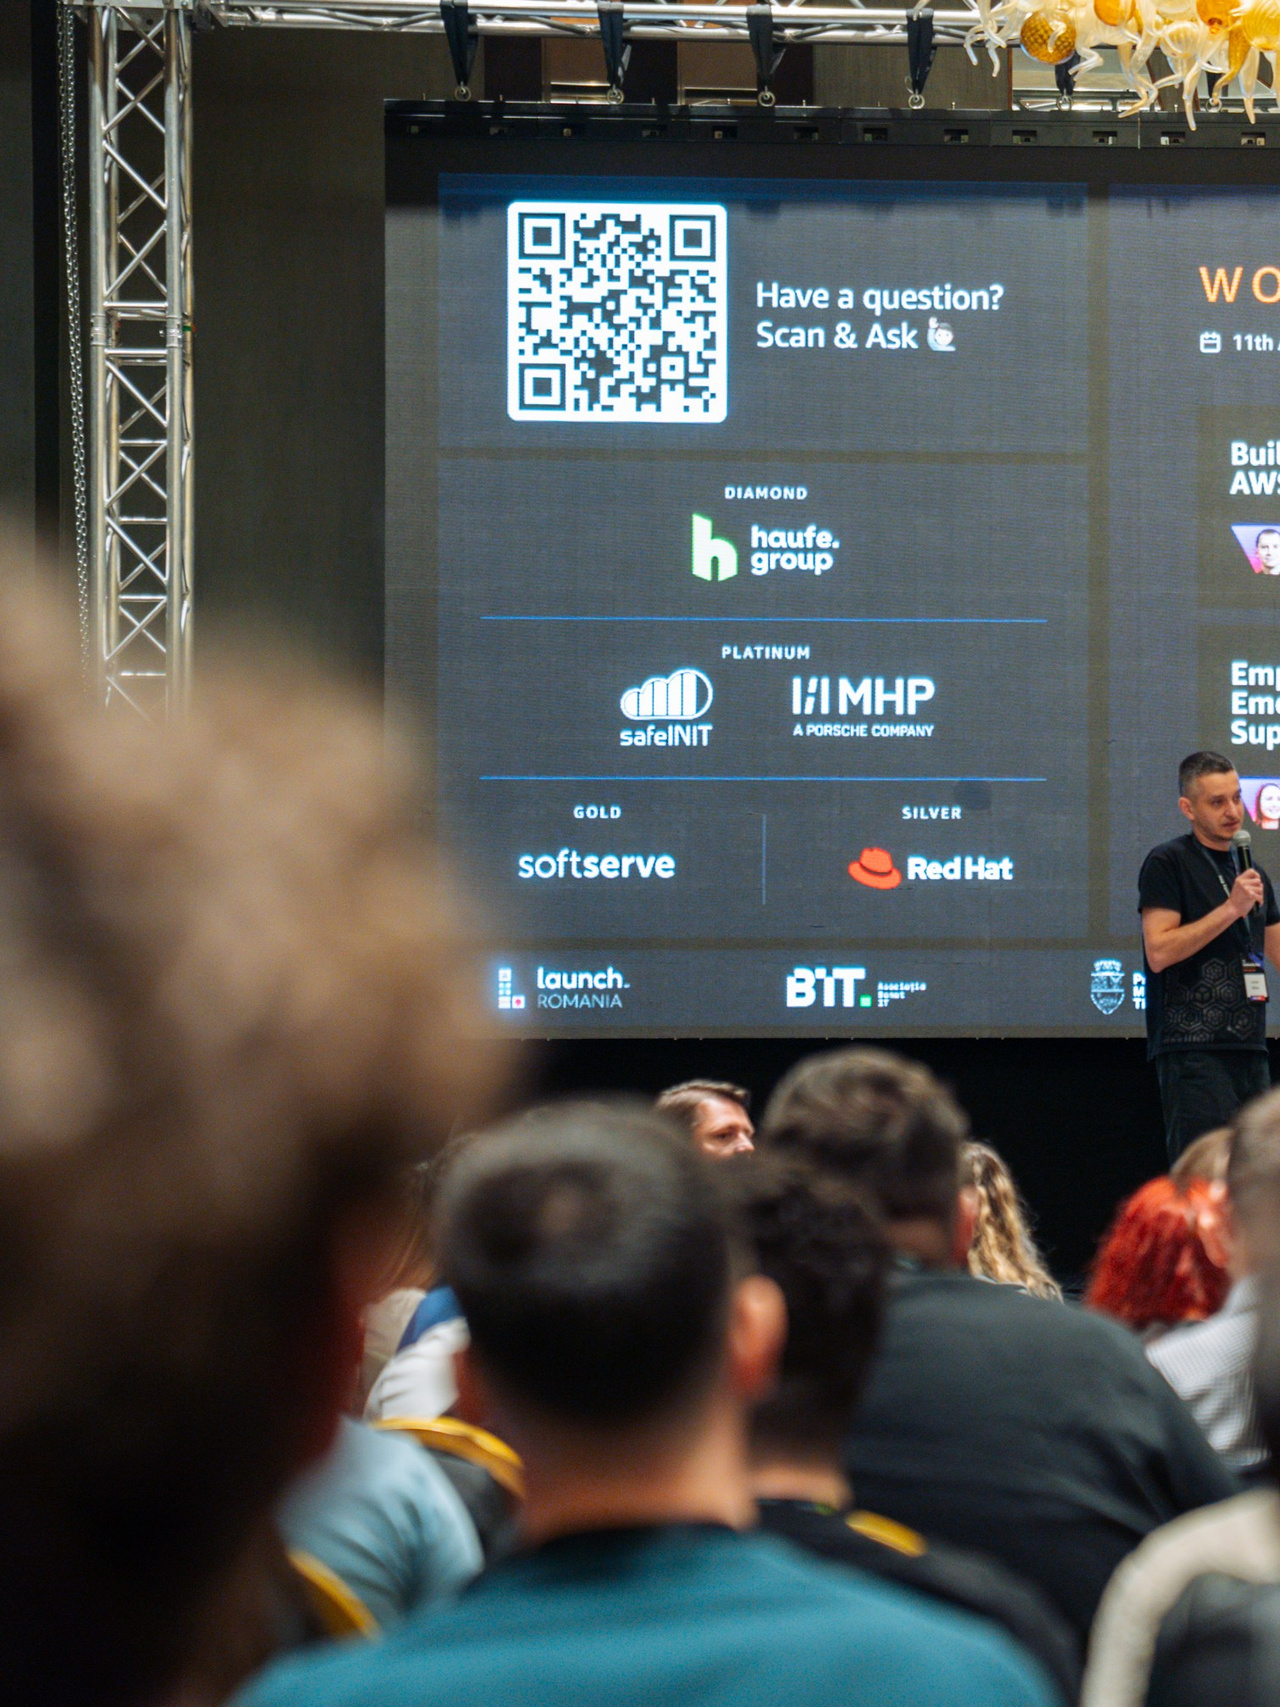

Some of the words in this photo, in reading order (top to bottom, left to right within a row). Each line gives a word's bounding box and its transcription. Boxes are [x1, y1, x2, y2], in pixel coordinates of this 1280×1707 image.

[757, 281, 830, 308] Have
[838, 288, 854, 309] a
[863, 283, 1004, 315] question?
[757, 320, 825, 348] Scan
[833, 321, 858, 349] &
[865, 321, 918, 349] Ask
[1233, 333, 1274, 351] 11th
[725, 486, 808, 500] DIAMOND
[751, 524, 840, 549] haufe.
[751, 550, 834, 576] group
[722, 645, 810, 659] PLATINUM
[838, 676, 936, 715] MHP
[620, 723, 713, 746] safeINIT
[793, 723, 804, 736] A
[806, 723, 868, 737] PORSCHE
[871, 723, 934, 737] COMPANY
[573, 804, 621, 819] GOLD
[902, 805, 961, 819] SILVER
[518, 847, 675, 878] softserve
[907, 855, 962, 880] Red
[964, 855, 1013, 880] Hat
[538, 993, 622, 1008] ROMANIA
